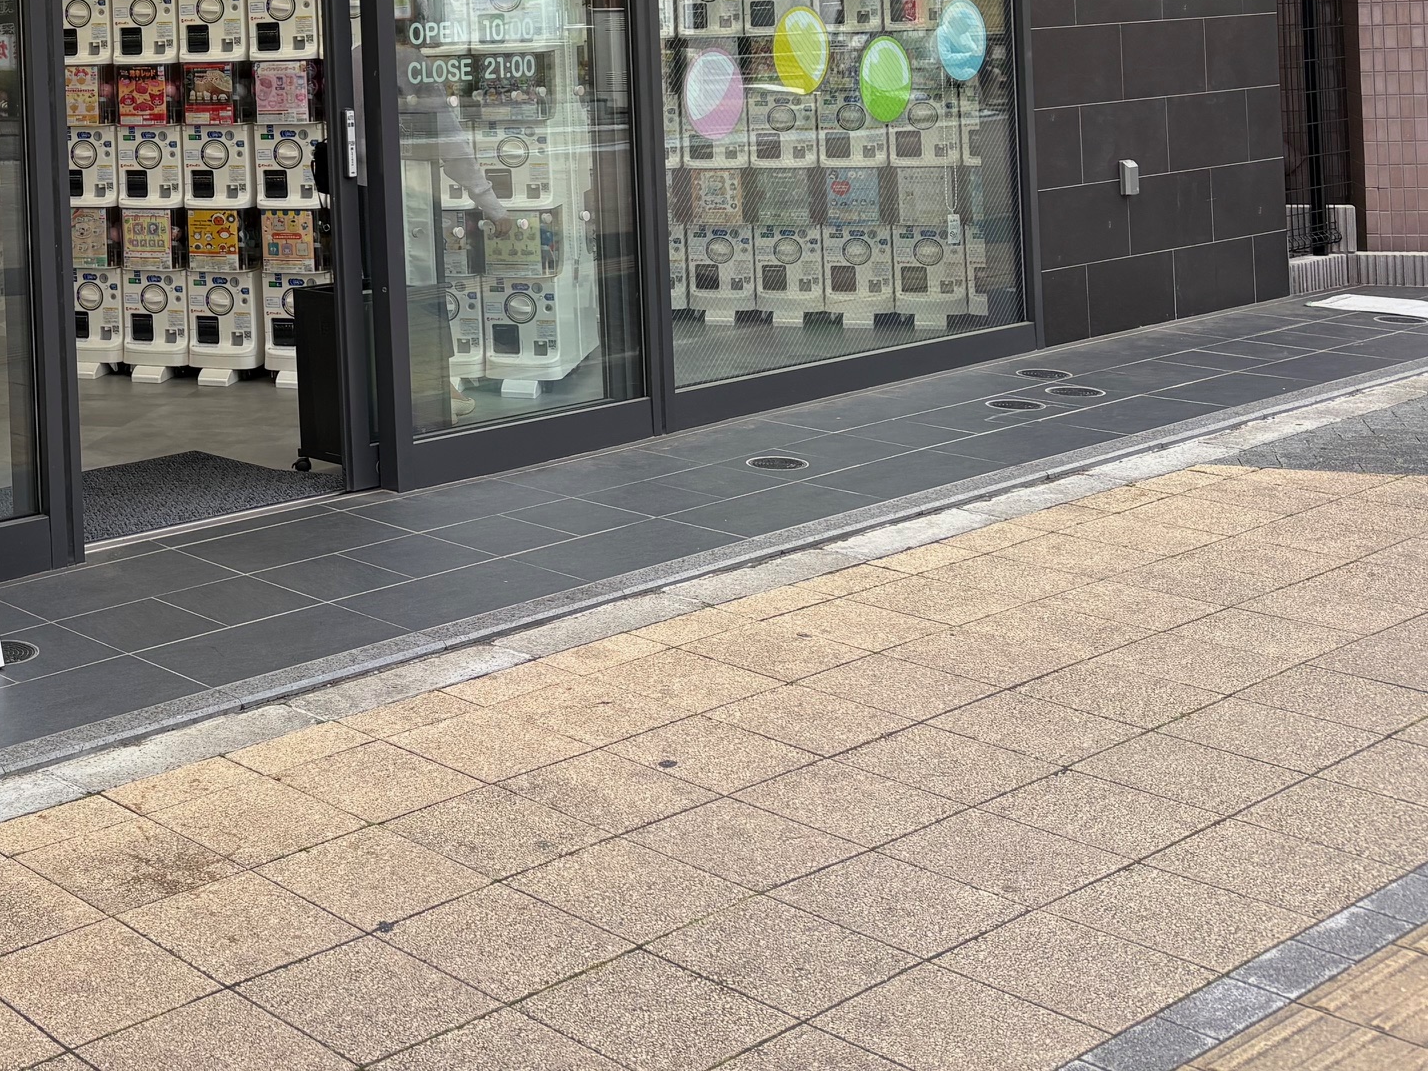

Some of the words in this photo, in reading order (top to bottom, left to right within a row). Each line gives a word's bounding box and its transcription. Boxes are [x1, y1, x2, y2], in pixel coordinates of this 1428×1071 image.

[409, 21, 468, 45] OPEN
[482, 18, 534, 41] 10:00
[407, 58, 472, 84] CLOSE
[484, 55, 535, 79] 21:00
